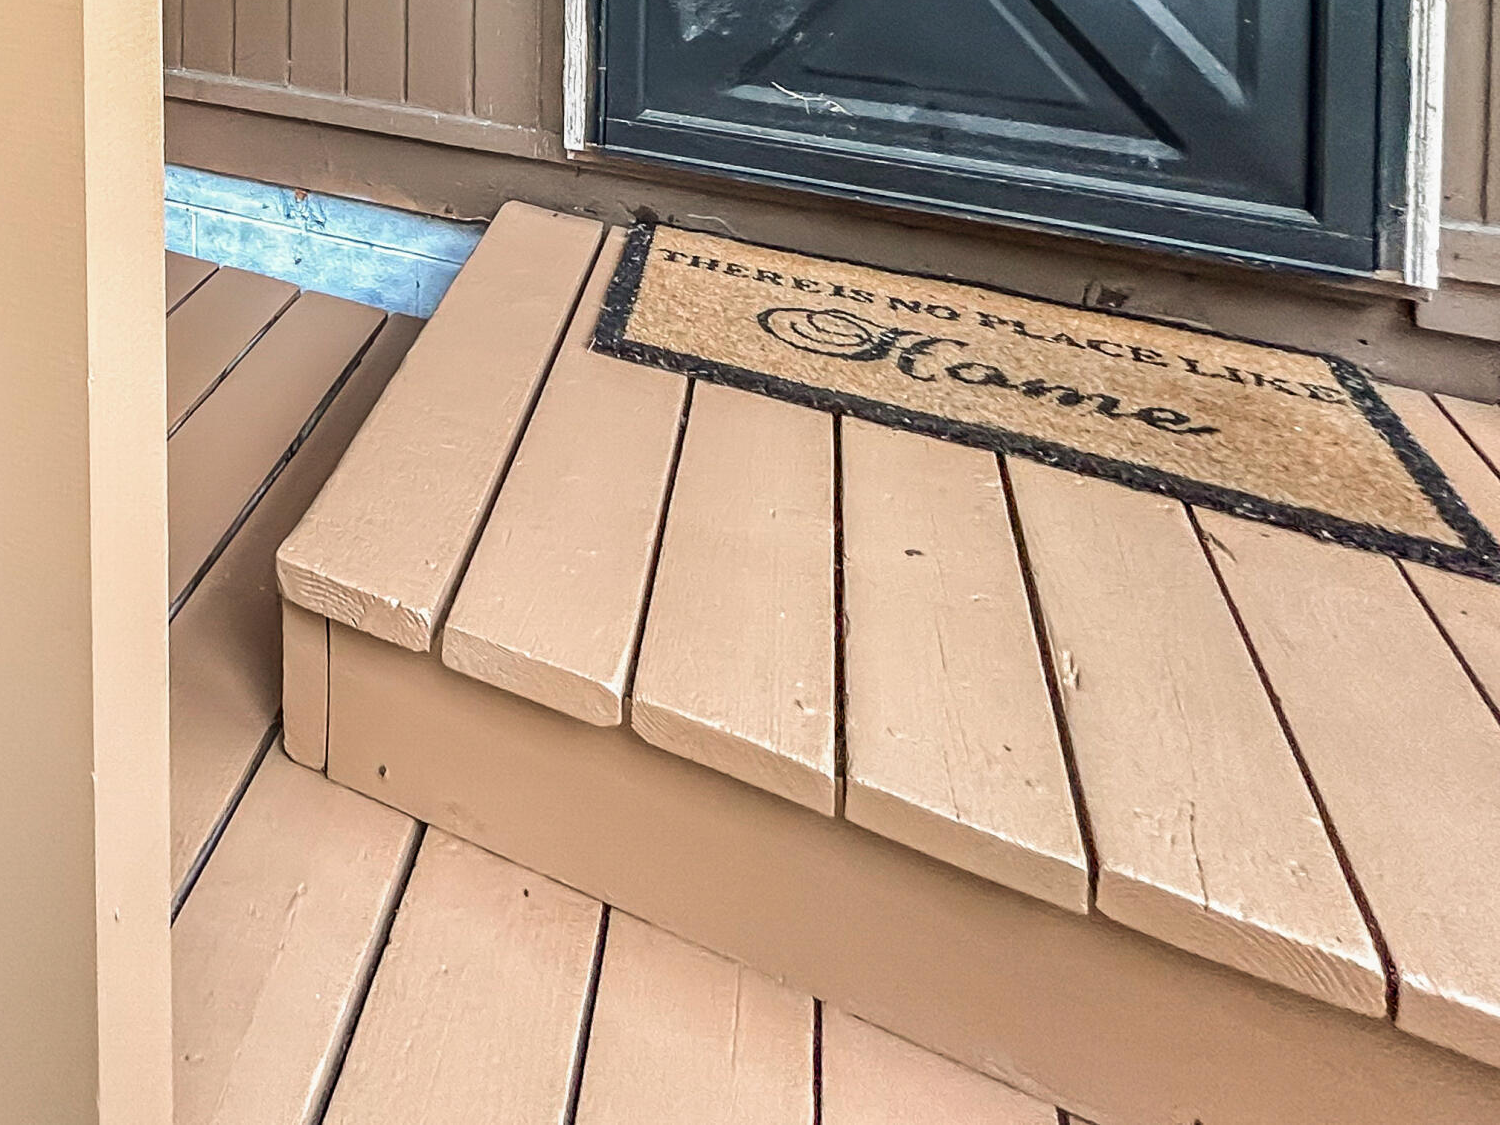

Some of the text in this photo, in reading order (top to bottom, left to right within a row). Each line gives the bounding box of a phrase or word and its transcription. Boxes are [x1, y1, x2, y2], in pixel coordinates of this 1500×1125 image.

[659, 248, 1349, 405] THERE IS NO PLACE LIKE
[757, 307, 1221, 435] Home
